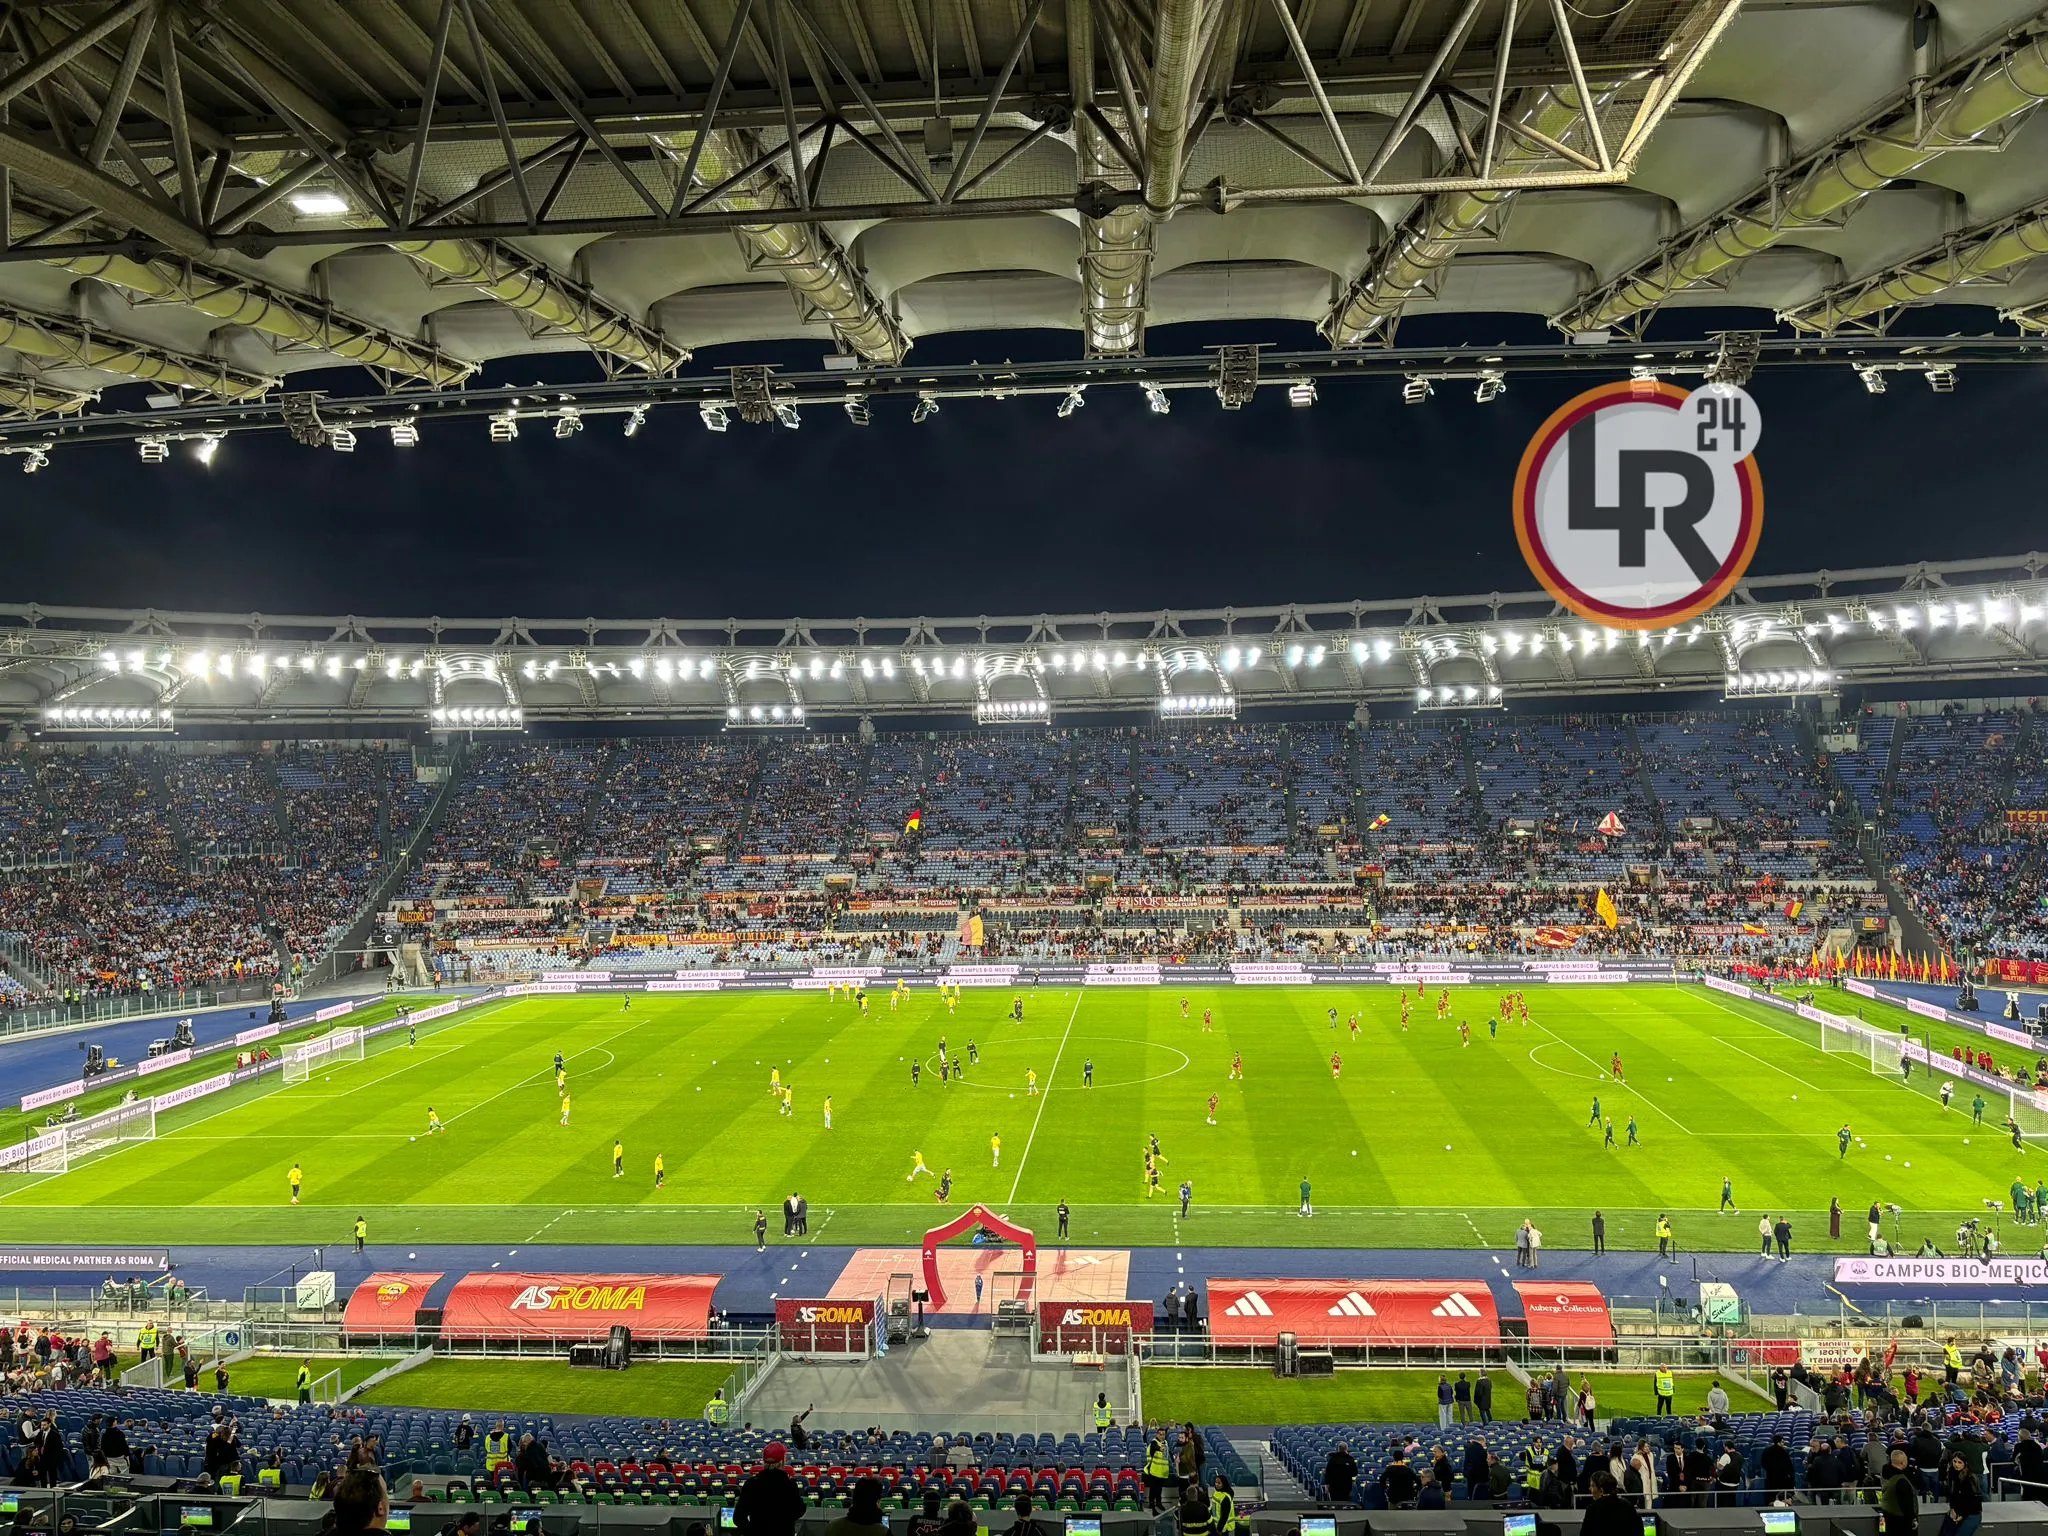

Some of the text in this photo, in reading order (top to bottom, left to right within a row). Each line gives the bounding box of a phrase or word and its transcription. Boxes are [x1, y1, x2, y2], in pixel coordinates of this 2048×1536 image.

[1133, 896, 1160, 907] SPQR
[167, 1090, 192, 1104] CAMPUS
[33, 1256, 71, 1265] MEDICAL
[73, 1256, 112, 1265] PARTNER
[114, 1256, 126, 1265] AS
[128, 1255, 154, 1265] ROMA
[1874, 1263, 1945, 1278] CAMPUS
[1529, 1304, 1604, 1314] Auberge Collection
